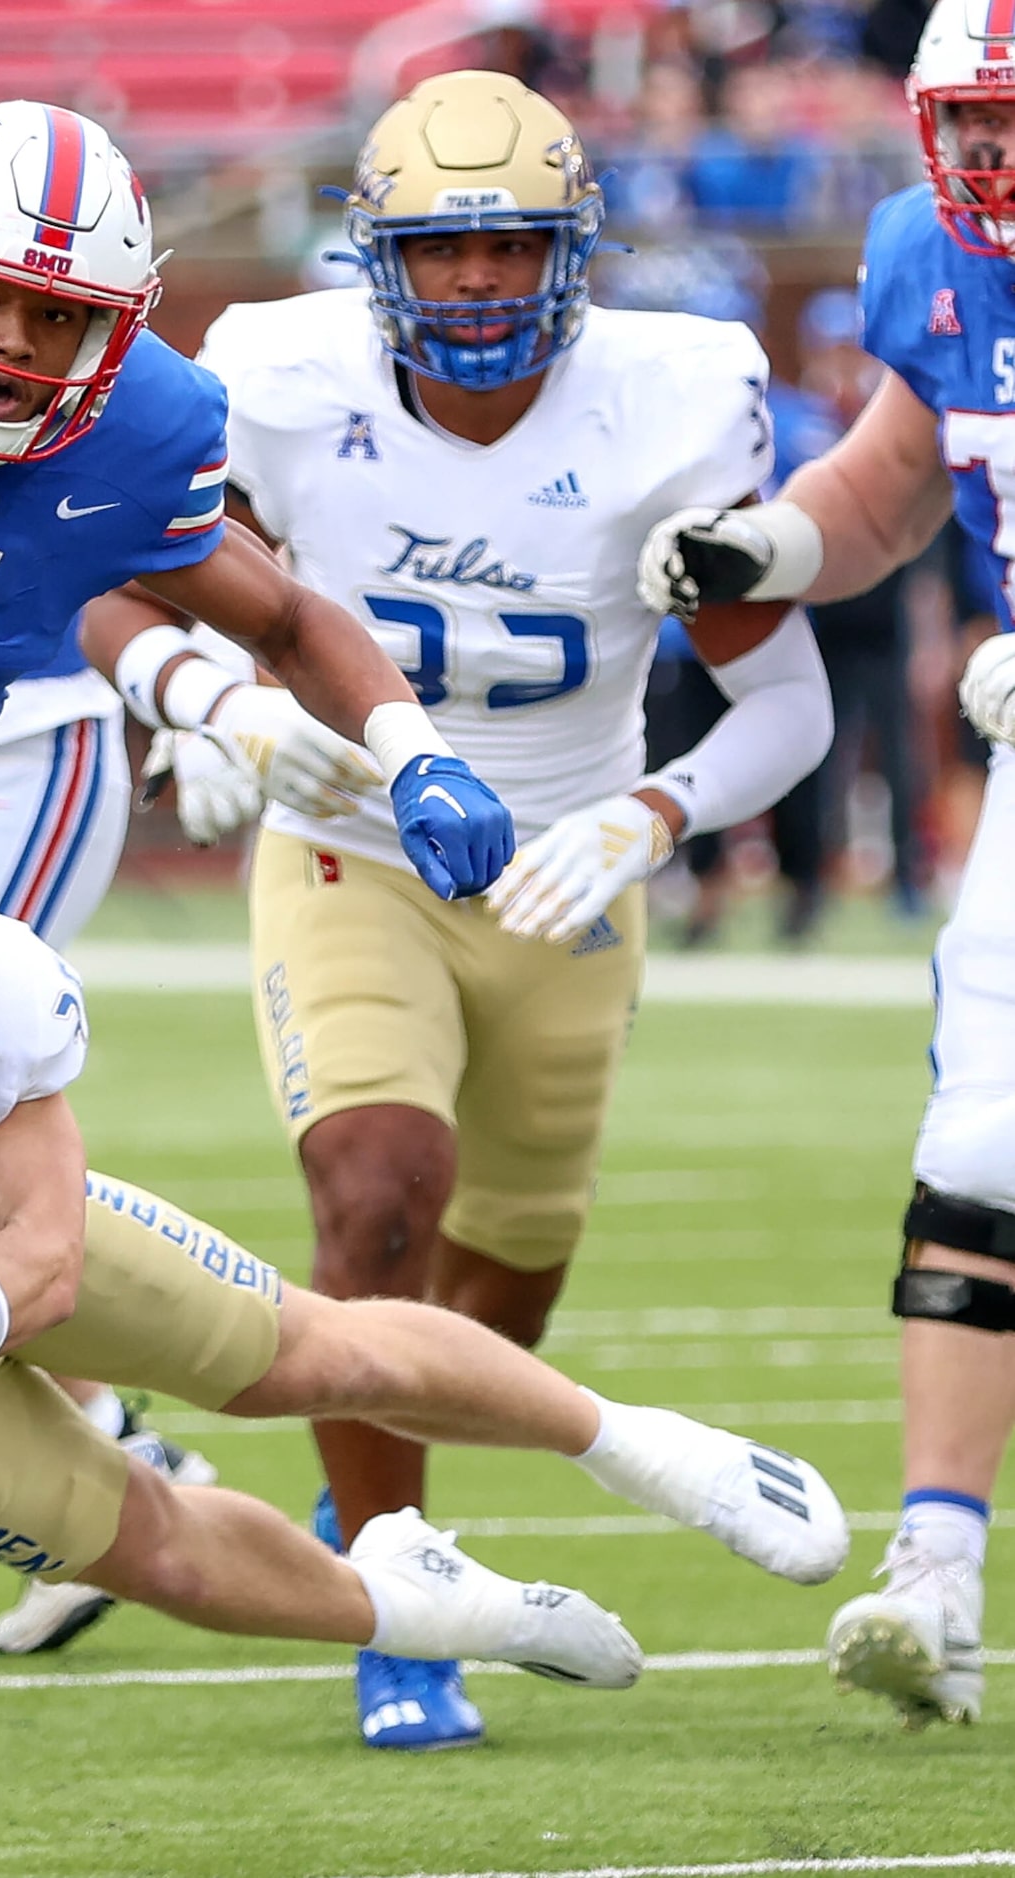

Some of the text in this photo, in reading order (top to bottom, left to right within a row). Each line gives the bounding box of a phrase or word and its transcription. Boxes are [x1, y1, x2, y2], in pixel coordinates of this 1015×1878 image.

[22, 247, 74, 275] SMU
[992, 336, 1015, 406] S
[336, 410, 380, 461] A
[378, 522, 535, 590] Tulsa
[86, 1178, 283, 1306] URRICAN
